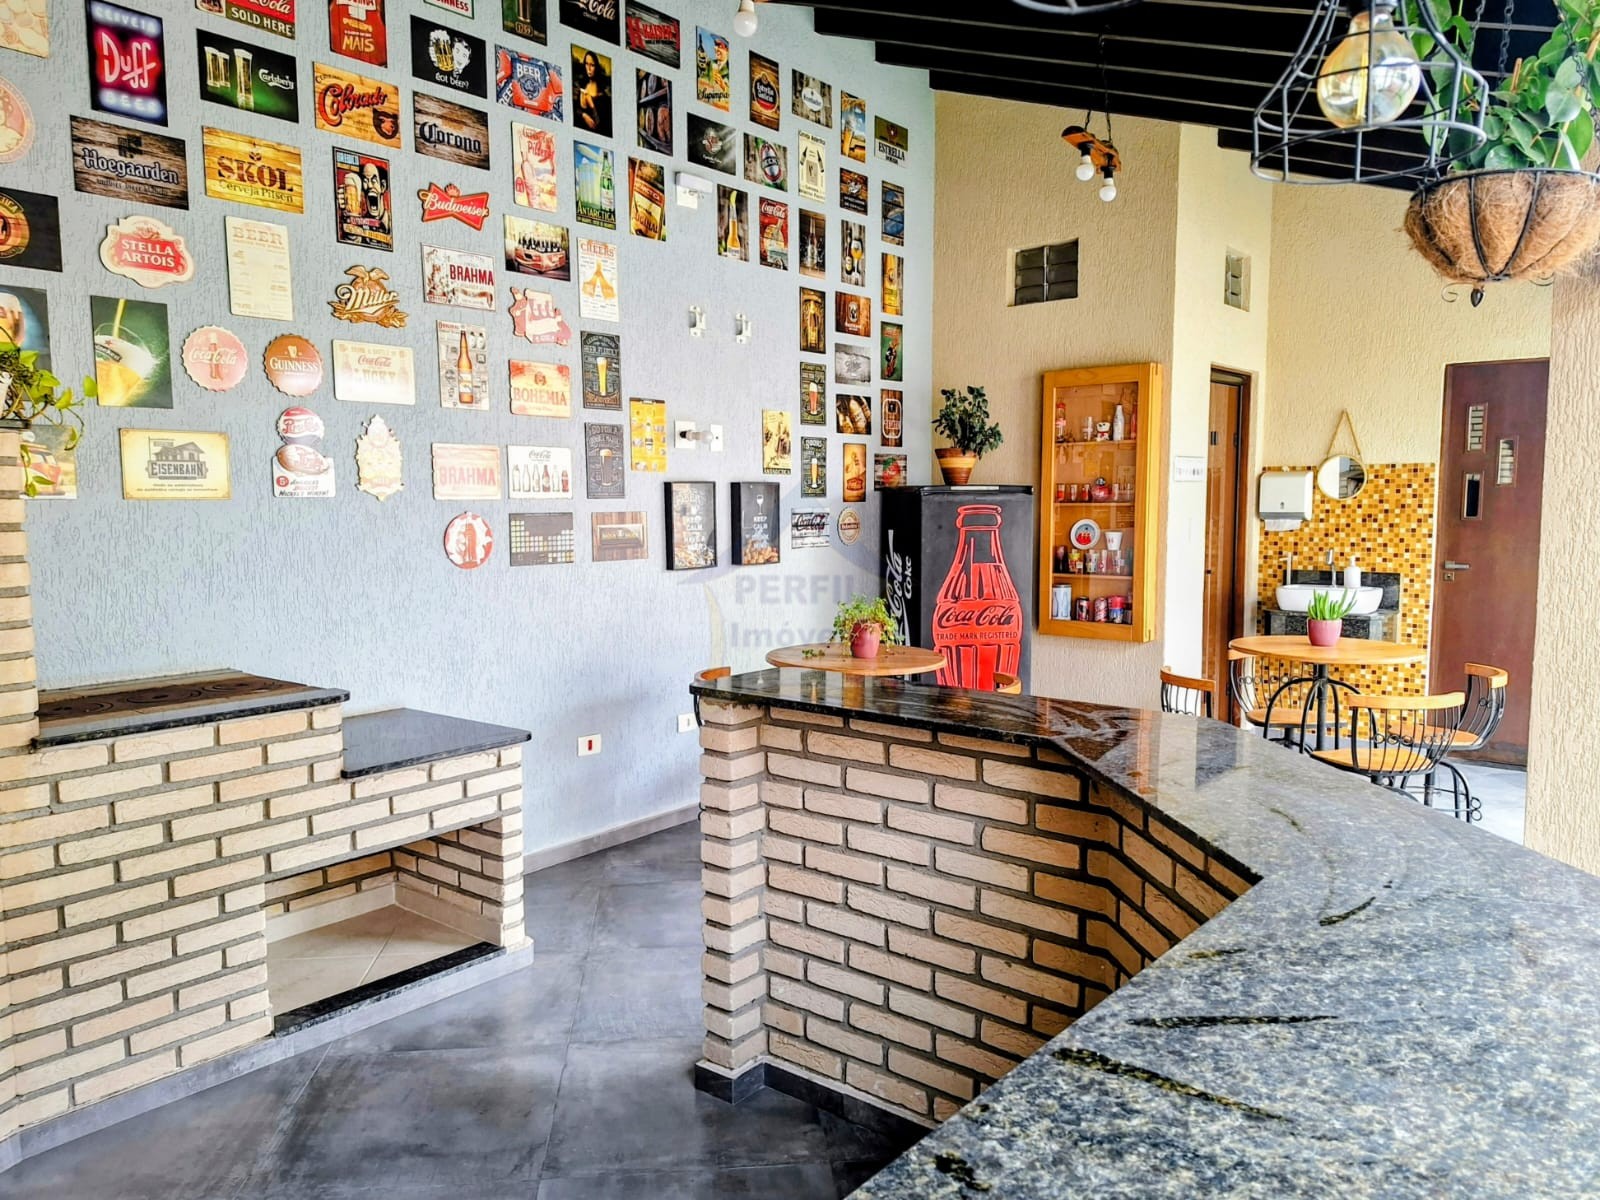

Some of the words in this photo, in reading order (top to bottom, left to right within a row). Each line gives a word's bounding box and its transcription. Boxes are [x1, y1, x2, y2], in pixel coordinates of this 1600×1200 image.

[231, 7, 261, 25] SOLD
[263, 17, 293, 36] HERE
[342, 35, 375, 53] MAIS
[101, 31, 157, 89] Duff
[258, 68, 295, 90] Carlsberg
[516, 62, 541, 82] BEER
[419, 120, 483, 154] Corona
[878, 141, 906, 161] ESTRELLA
[82, 147, 179, 187] Hoegaarden
[216, 155, 295, 193] SKOL
[219, 180, 259, 197] Cerveja
[261, 187, 294, 204] Pilsen
[424, 193, 489, 217] Budweiser
[577, 202, 617, 223] ANTARCTICA
[231, 226, 284, 246] BEER
[121, 238, 175, 256] STELLA
[580, 241, 615, 258] CHEERS
[120, 251, 176, 268] ARTOIS
[449, 263, 495, 287] BRAHMA
[335, 284, 399, 313] Miller
[269, 356, 319, 372] GUINNESS
[513, 386, 568, 407] BOHEMIA
[150, 461, 205, 478] EISENBAHN
[439, 464, 497, 487] BRAHMA
[904, 555, 913, 600] Coke
[936, 632, 959, 641] TRADE
[960, 632, 978, 640] MARK
[980, 631, 1019, 640] REGISTERED
